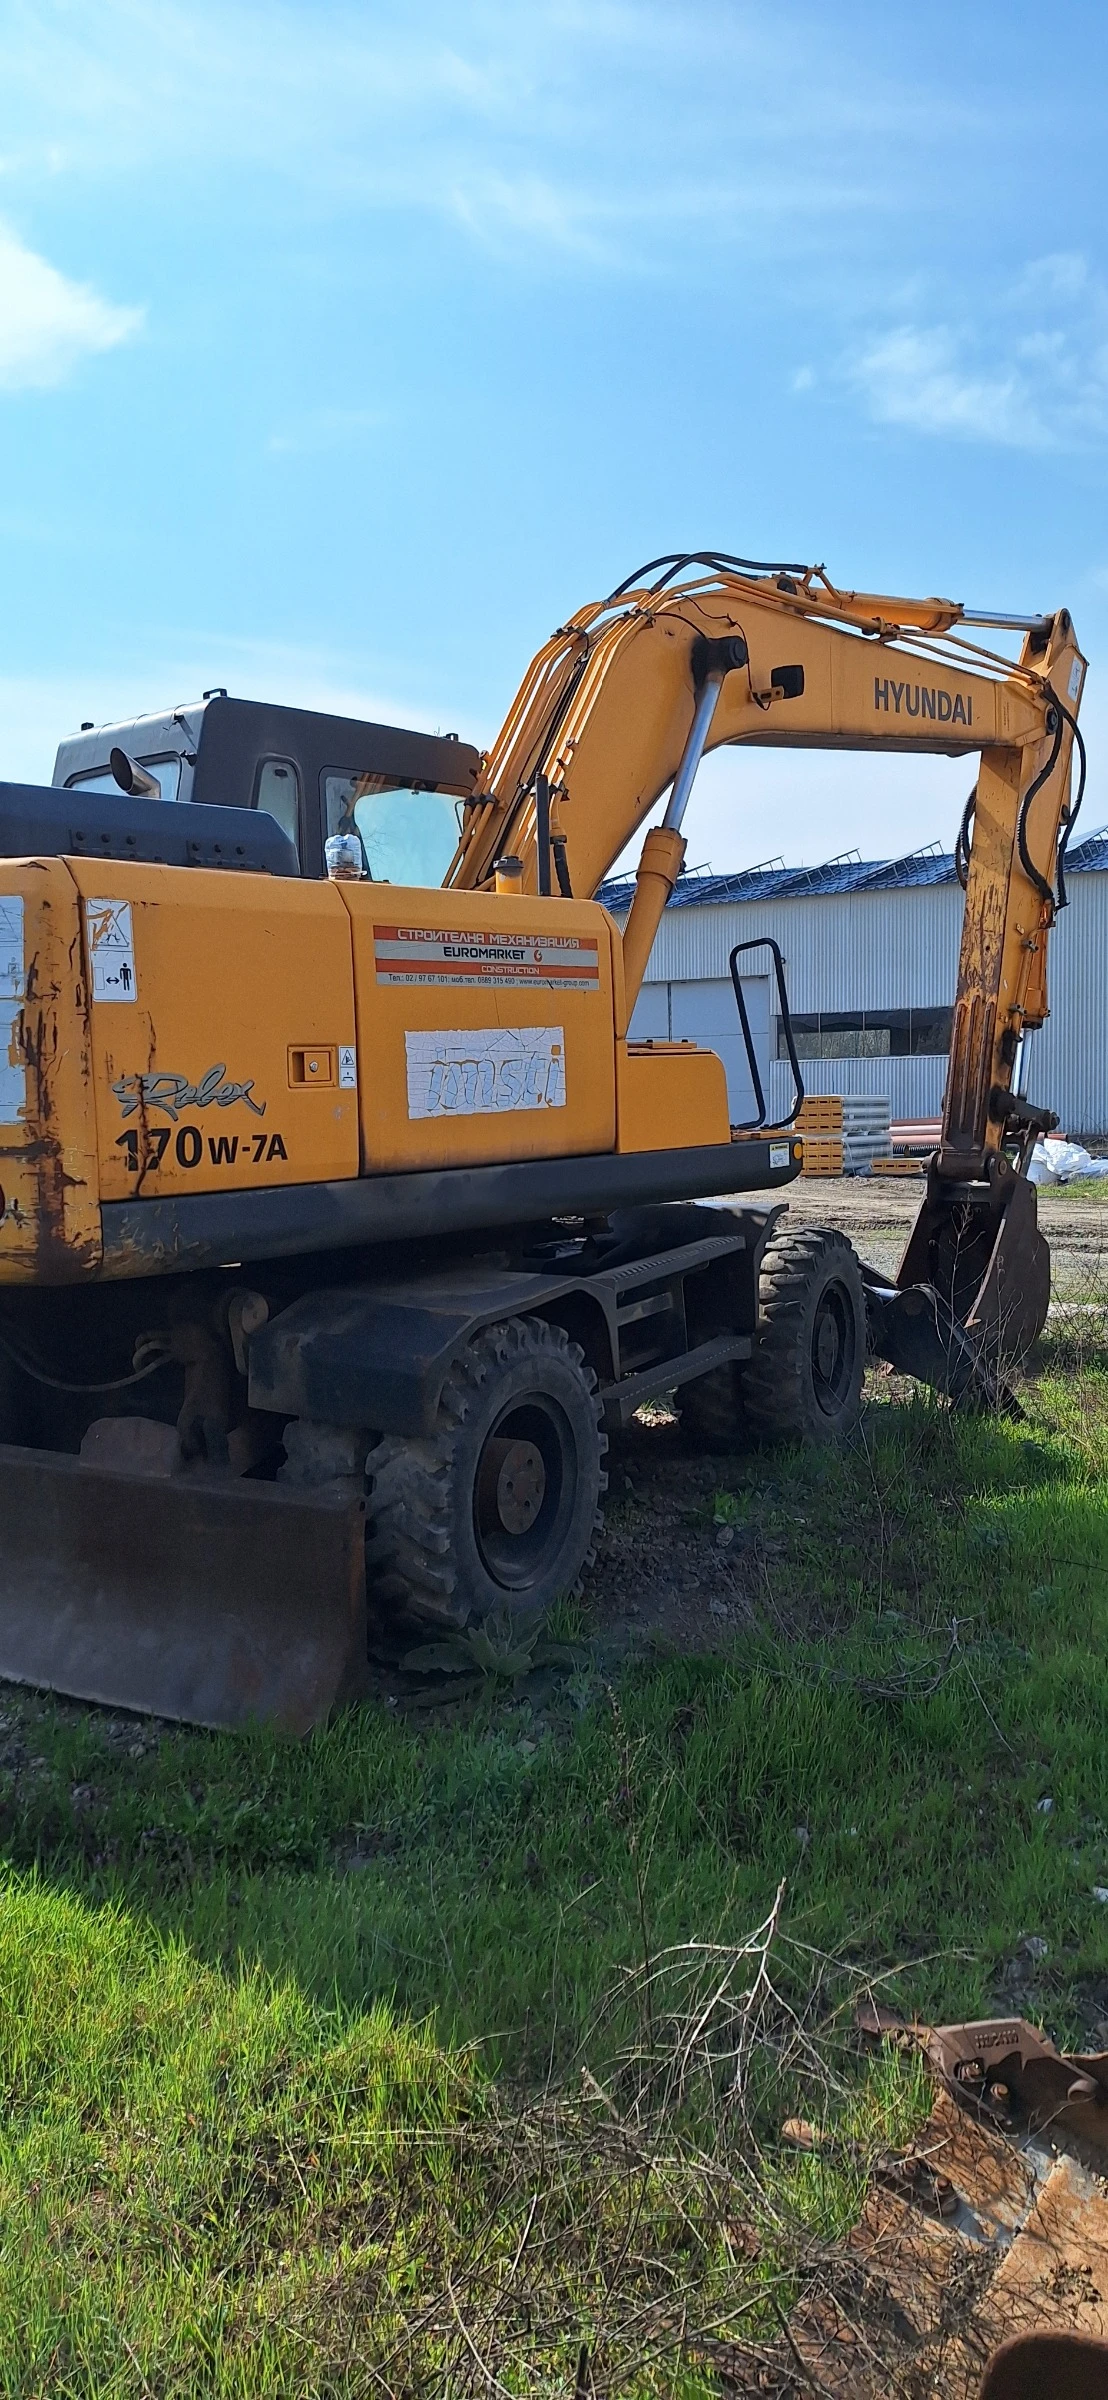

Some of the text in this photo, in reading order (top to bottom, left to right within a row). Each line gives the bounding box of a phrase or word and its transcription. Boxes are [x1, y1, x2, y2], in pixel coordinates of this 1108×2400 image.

[875, 677, 972, 726] HYUNDAI
[397, 928, 580, 949] СТРОИТЕЛНА МЕХАНИЗАЦИЯ
[443, 946, 526, 960] EUROMARKET
[418, 974, 426, 982] 97
[481, 965, 540, 975] CONSTRUCTION
[112, 1063, 266, 1121] Robex
